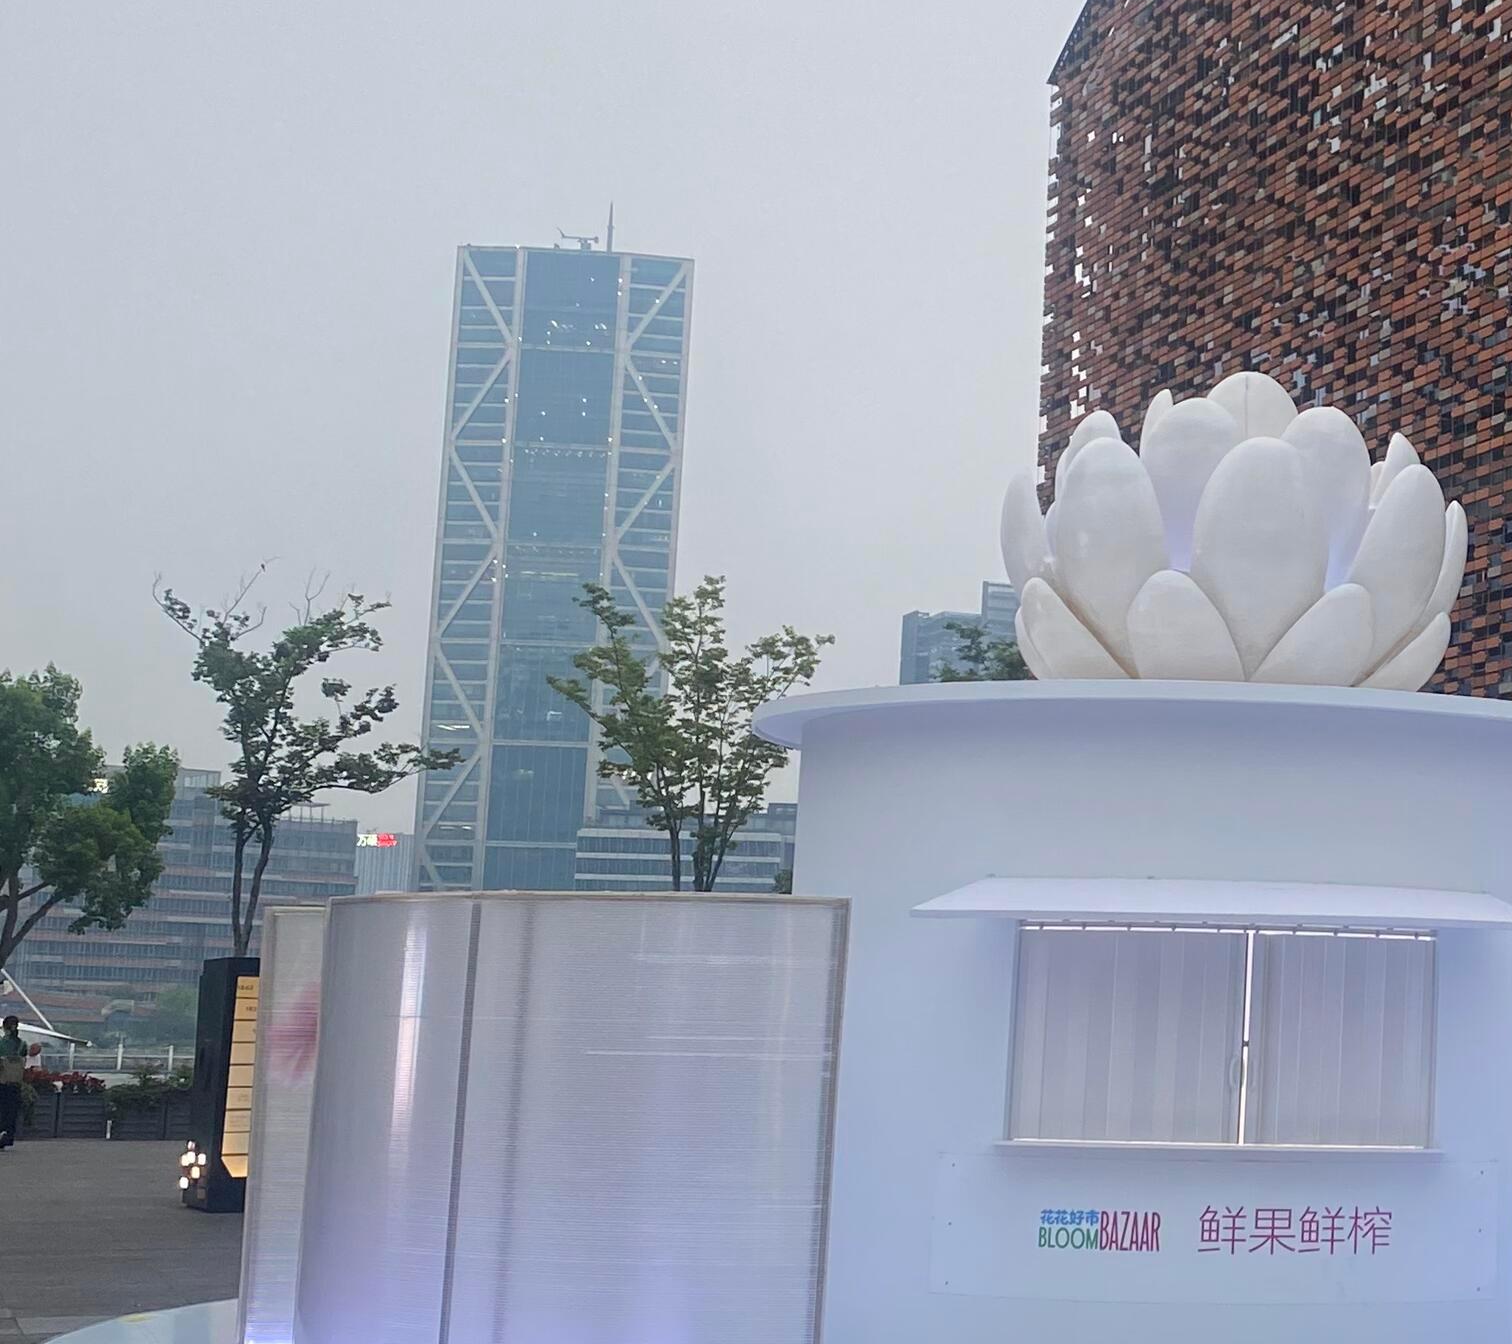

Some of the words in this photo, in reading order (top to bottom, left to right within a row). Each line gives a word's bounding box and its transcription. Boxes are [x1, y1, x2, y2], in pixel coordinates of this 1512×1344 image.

[1038, 1226, 1098, 1249] BLOOM
[1099, 1210, 1161, 1251] BAZAAR
[1040, 1208, 1099, 1226] 花花好市
[1197, 1205, 1392, 1255] 鲜果鲜榨
